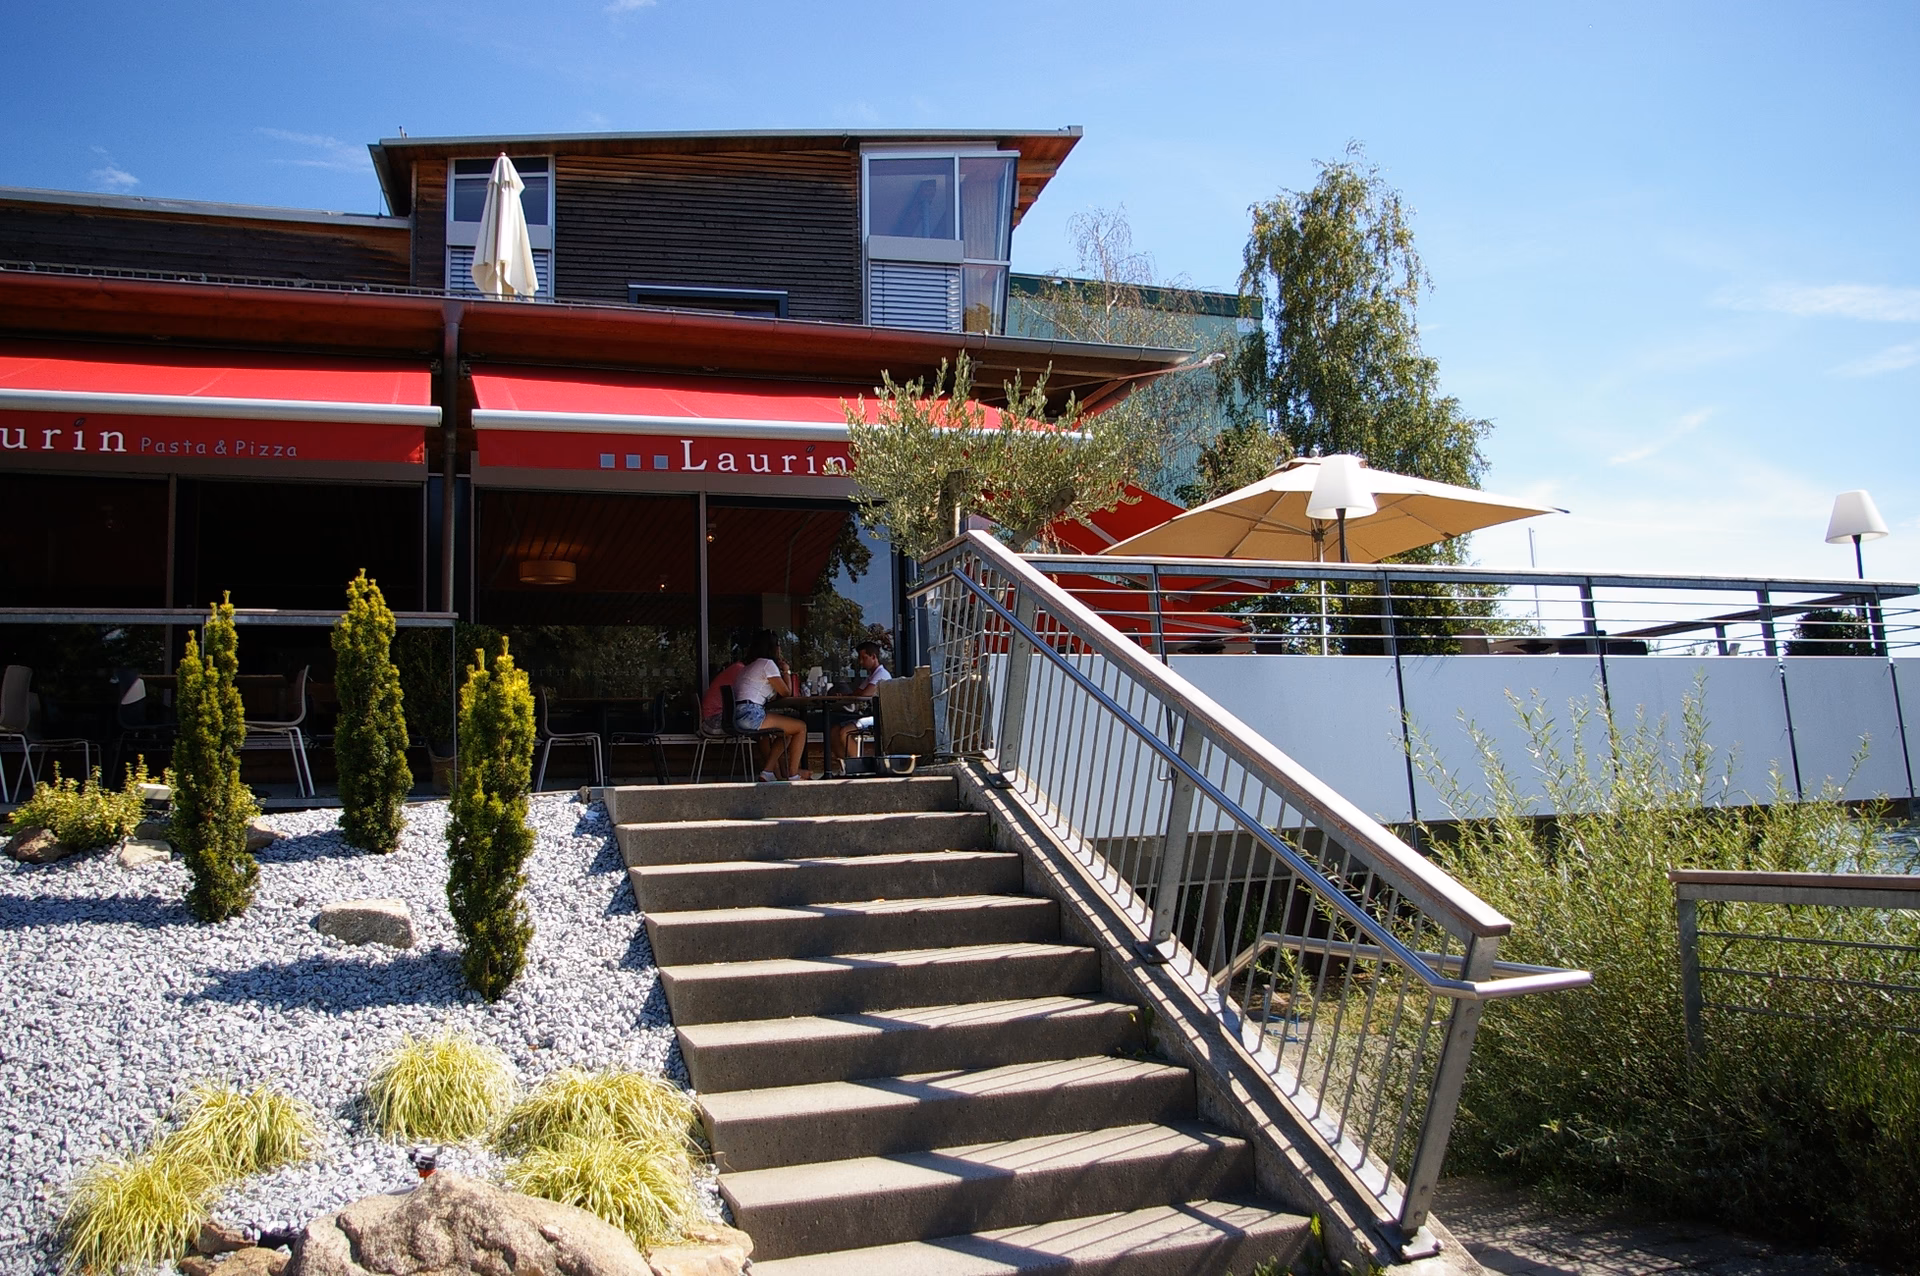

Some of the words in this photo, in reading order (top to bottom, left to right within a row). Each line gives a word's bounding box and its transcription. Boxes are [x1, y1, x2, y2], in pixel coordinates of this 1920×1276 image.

[141, 436, 207, 455] Pasta
[214, 439, 227, 455] &
[235, 440, 297, 457] Pizza
[680, 439, 849, 476] Laurin
